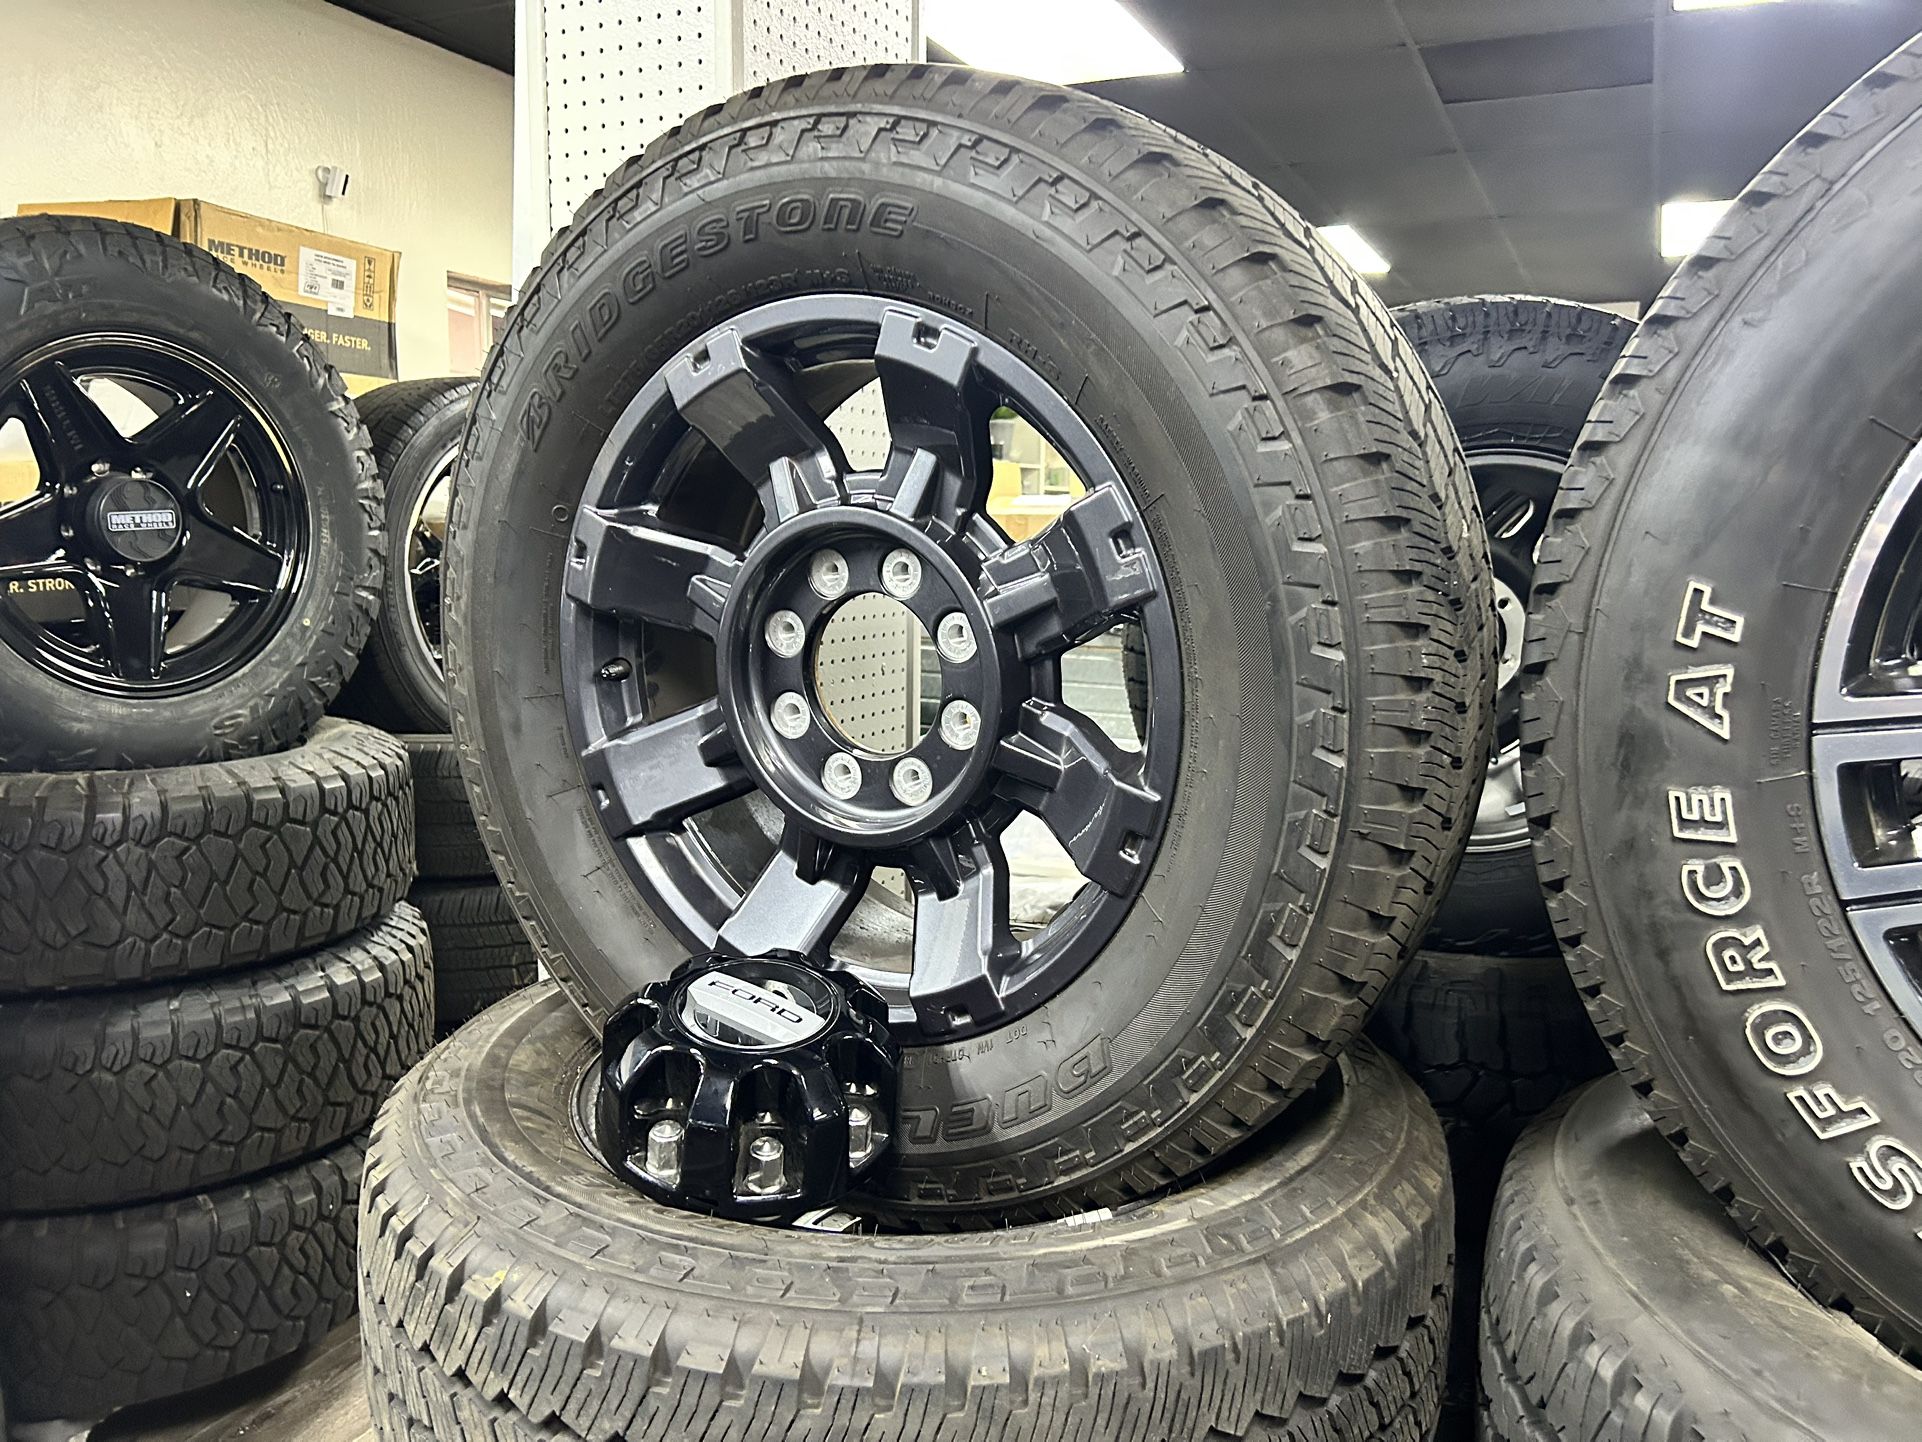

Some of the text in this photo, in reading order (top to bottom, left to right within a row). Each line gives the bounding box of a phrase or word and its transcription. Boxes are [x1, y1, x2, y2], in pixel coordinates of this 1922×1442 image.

[207, 238, 287, 268] METHOD
[241, 259, 286, 275] WHEELS
[332, 333, 372, 351] FASTER.
[519, 190, 916, 452] BRIDGESTONE
[111, 512, 173, 524] METHOD
[1786, 802, 1810, 855] M+S
[1667, 579, 1922, 1238] SFORCE AT
[1801, 871, 1883, 1016] 125/122R
[708, 980, 803, 1023] FORD
